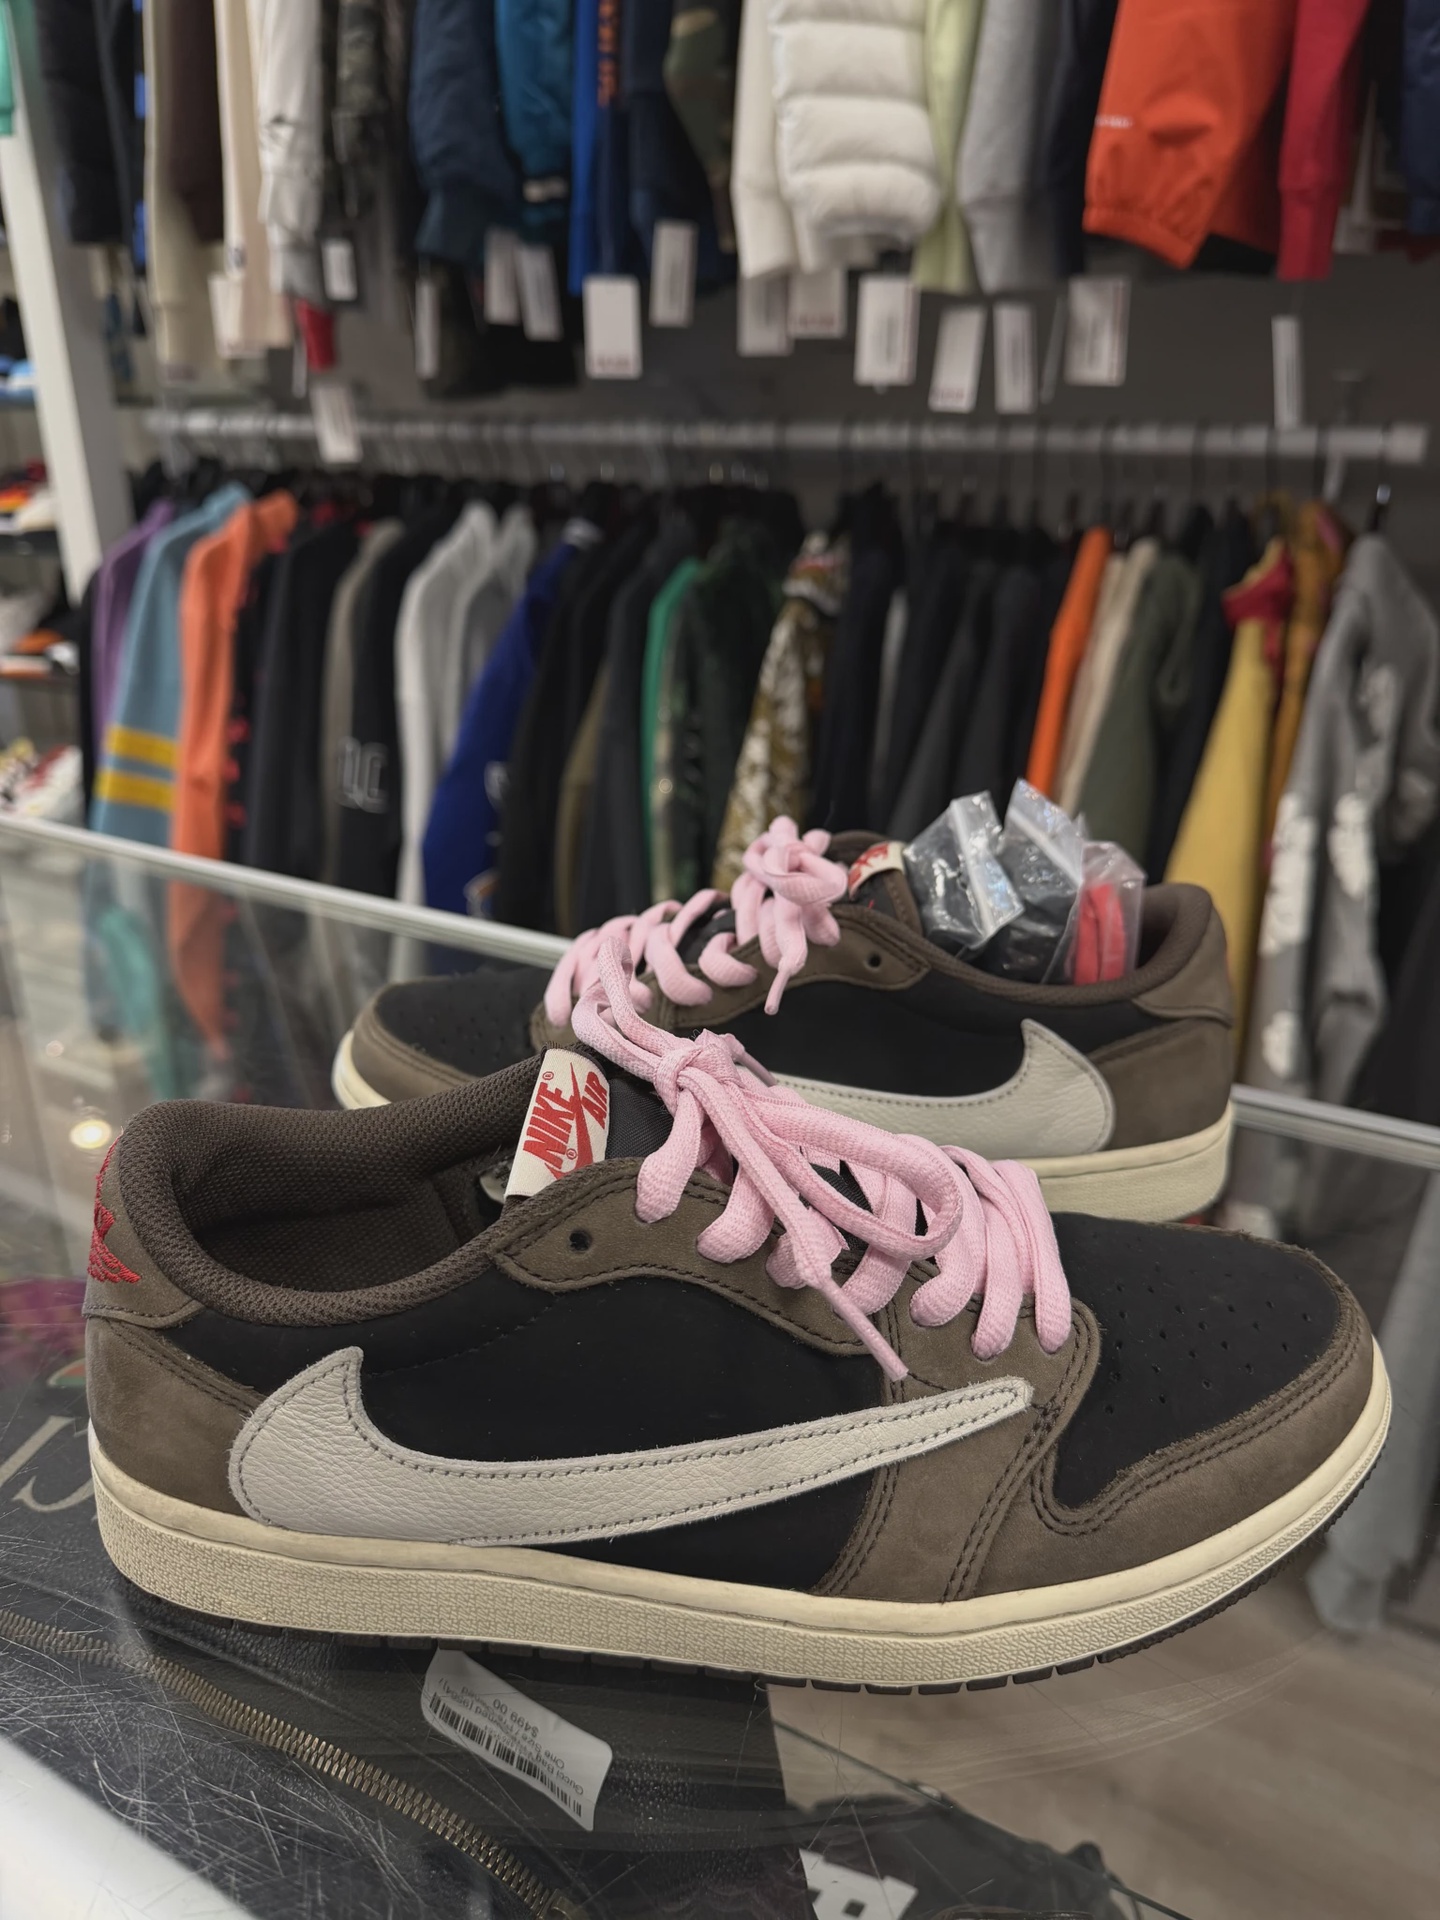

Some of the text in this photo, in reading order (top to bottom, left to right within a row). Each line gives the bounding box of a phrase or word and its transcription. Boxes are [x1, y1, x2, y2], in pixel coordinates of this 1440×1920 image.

[580, 1071, 608, 1130] AIR
[523, 1081, 576, 1170] NIKE
[493, 1699, 539, 1738] $499.00
[521, 1733, 542, 1752] Size
[535, 1753, 555, 1773] Bag
[544, 1749, 565, 1769] One
[556, 1770, 584, 1796] Gucci
